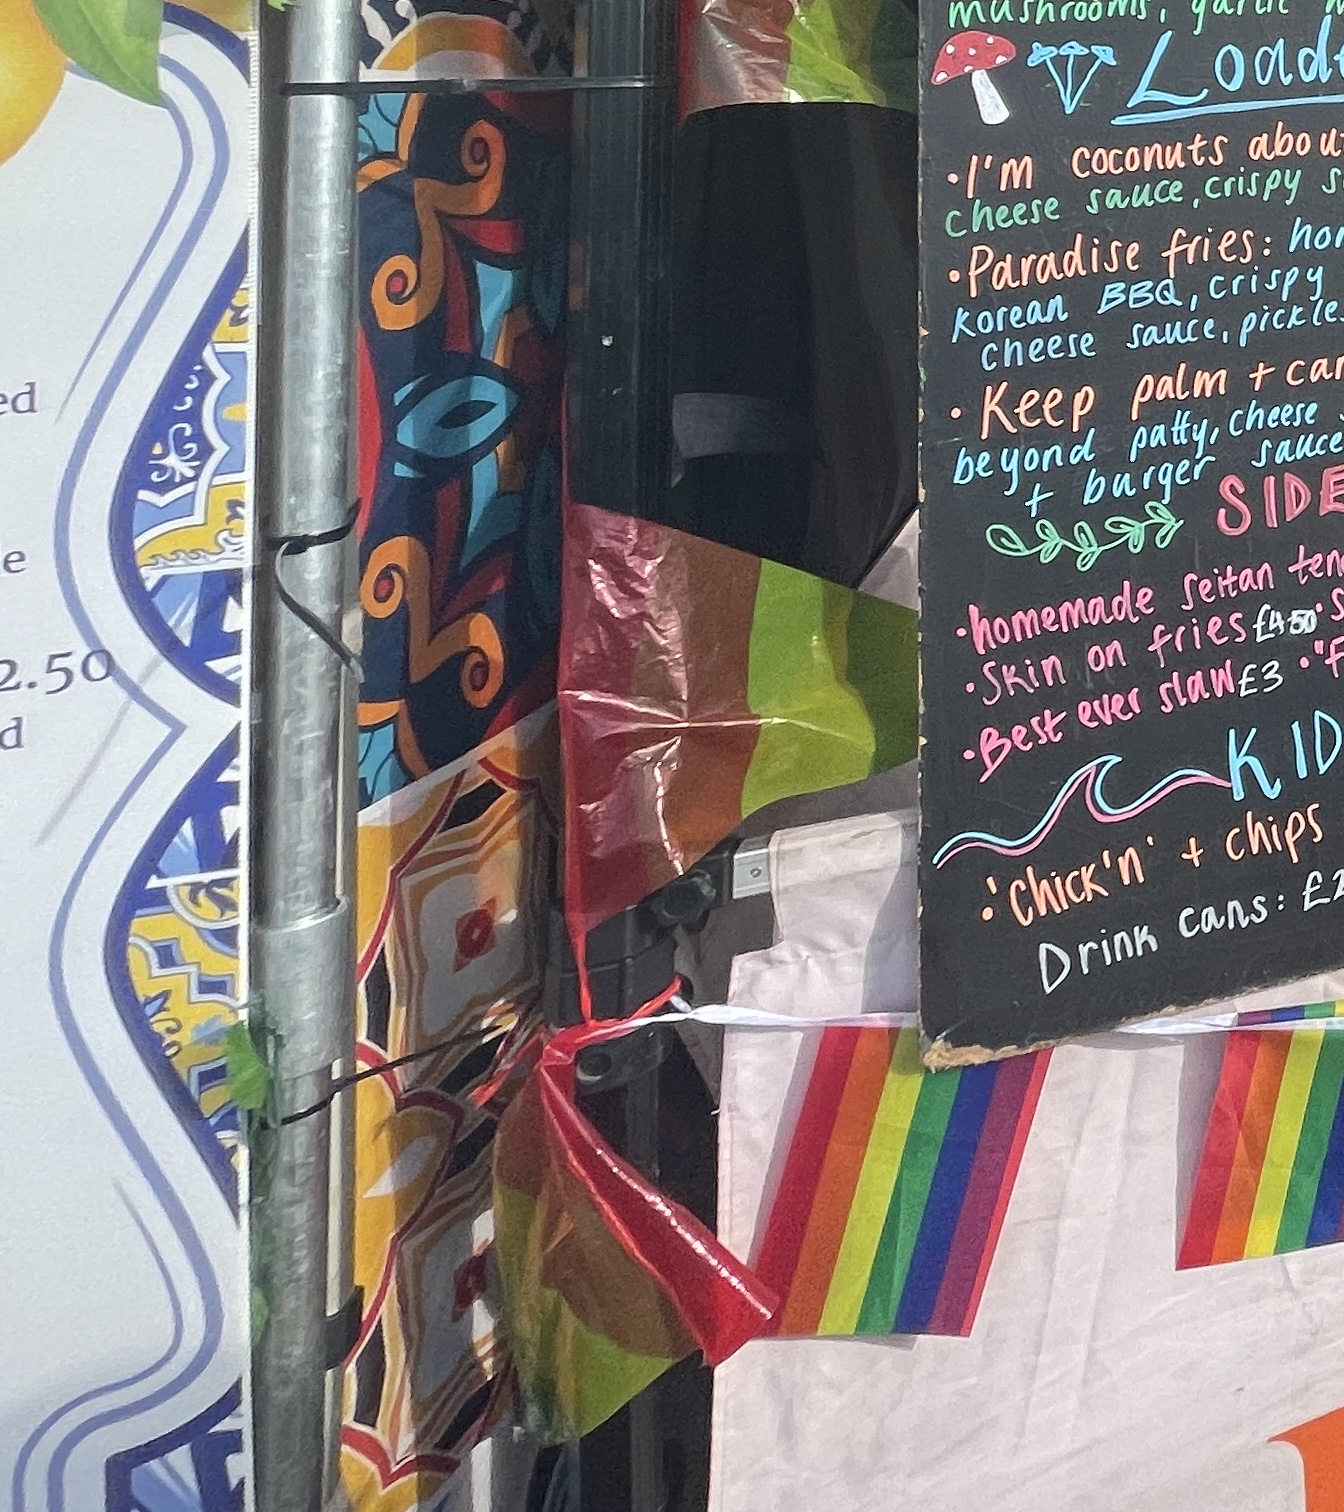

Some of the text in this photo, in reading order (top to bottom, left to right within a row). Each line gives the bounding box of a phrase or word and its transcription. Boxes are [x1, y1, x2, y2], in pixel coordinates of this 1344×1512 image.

[967, 155, 1032, 198] I'm
[1072, 134, 1228, 178] coconuts
[946, 197, 1059, 237] cheese
[1205, 167, 1301, 205] crispy
[968, 233, 1139, 302] Paradise
[1209, 266, 1323, 308] crispy
[982, 333, 1096, 370] cheese
[981, 382, 1095, 440] Keep
[1132, 363, 1227, 420] palm
[950, 436, 1101, 501] beyond
[1229, 400, 1318, 436] cheese
[1083, 432, 1343, 505] burger sauce
[969, 581, 1154, 660] homemade
[1181, 562, 1274, 610] seitan
[1148, 613, 1246, 668] fries
[980, 659, 1283, 774] Best ever slaw £3
[1039, 925, 1158, 994] Drink
